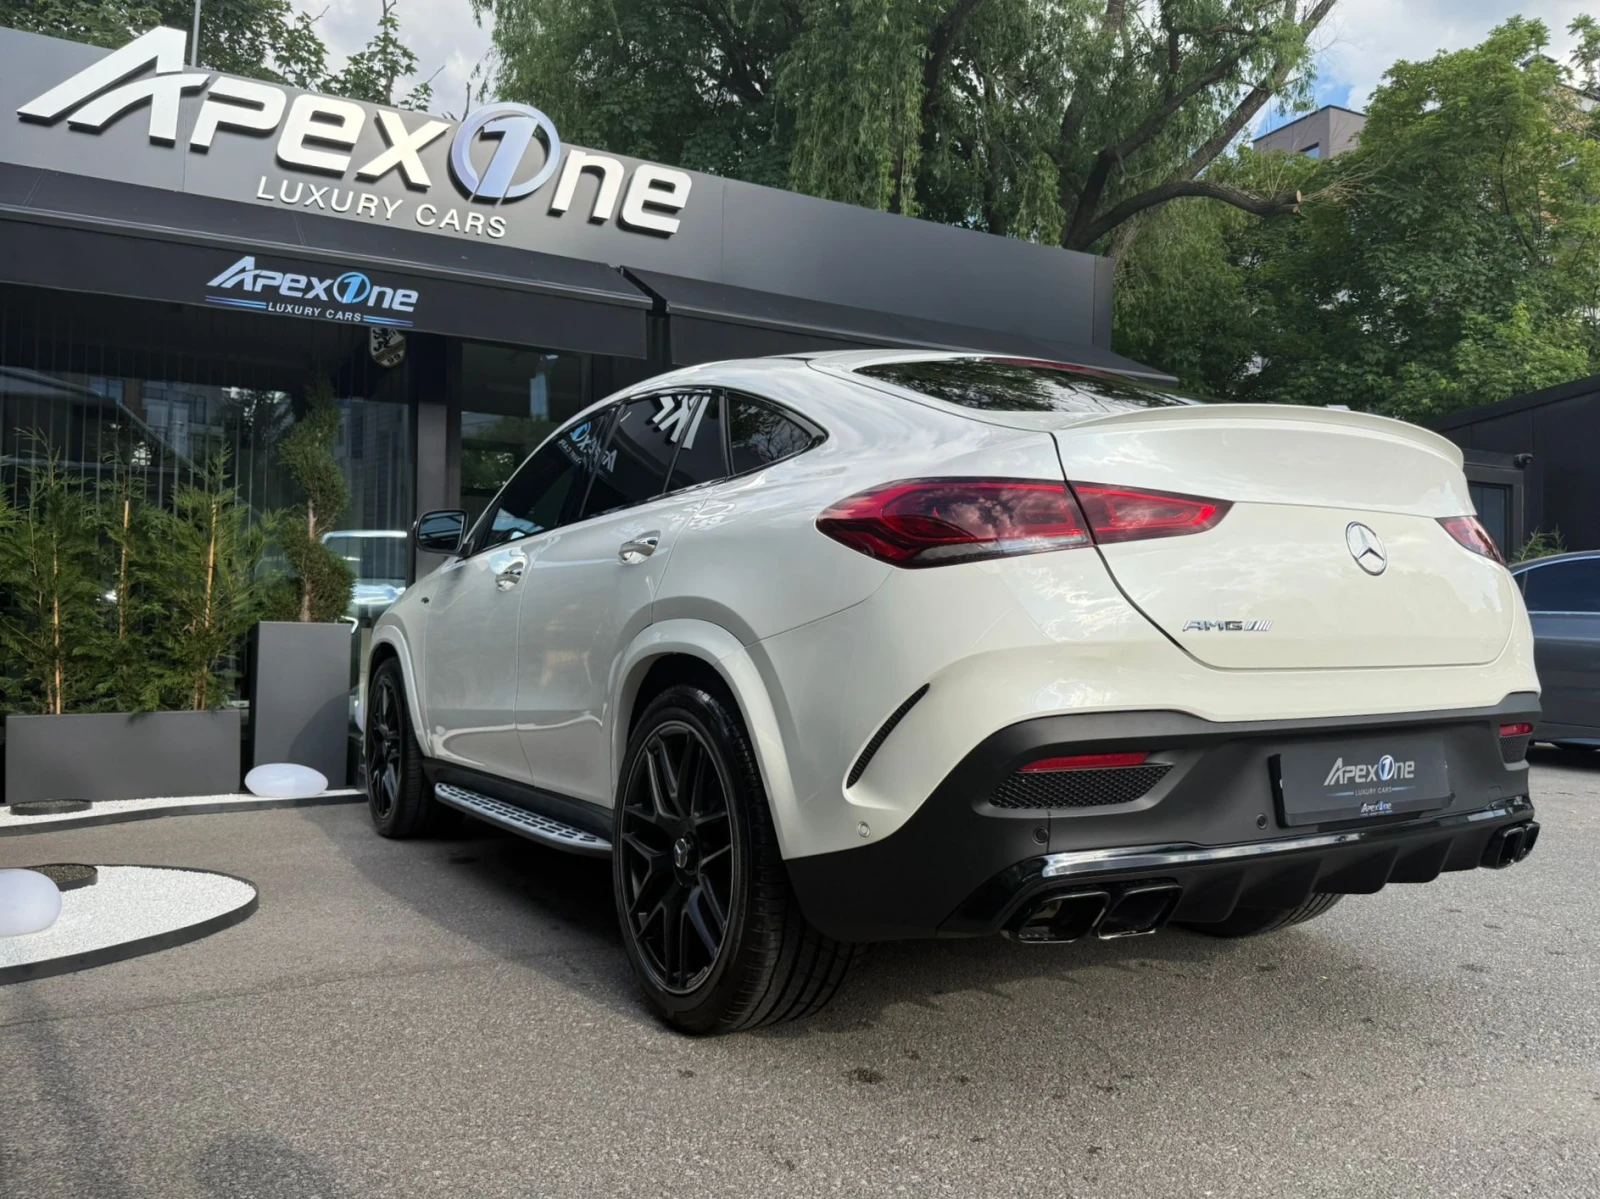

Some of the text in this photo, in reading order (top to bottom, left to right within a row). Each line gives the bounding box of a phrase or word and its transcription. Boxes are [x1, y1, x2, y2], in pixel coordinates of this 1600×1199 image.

[256, 176, 507, 238] LUXURY CARS
[267, 301, 362, 322] LUXURY CARS
[1182, 620, 1243, 632] AMG
[1354, 786, 1393, 796] LUXURY CARS
